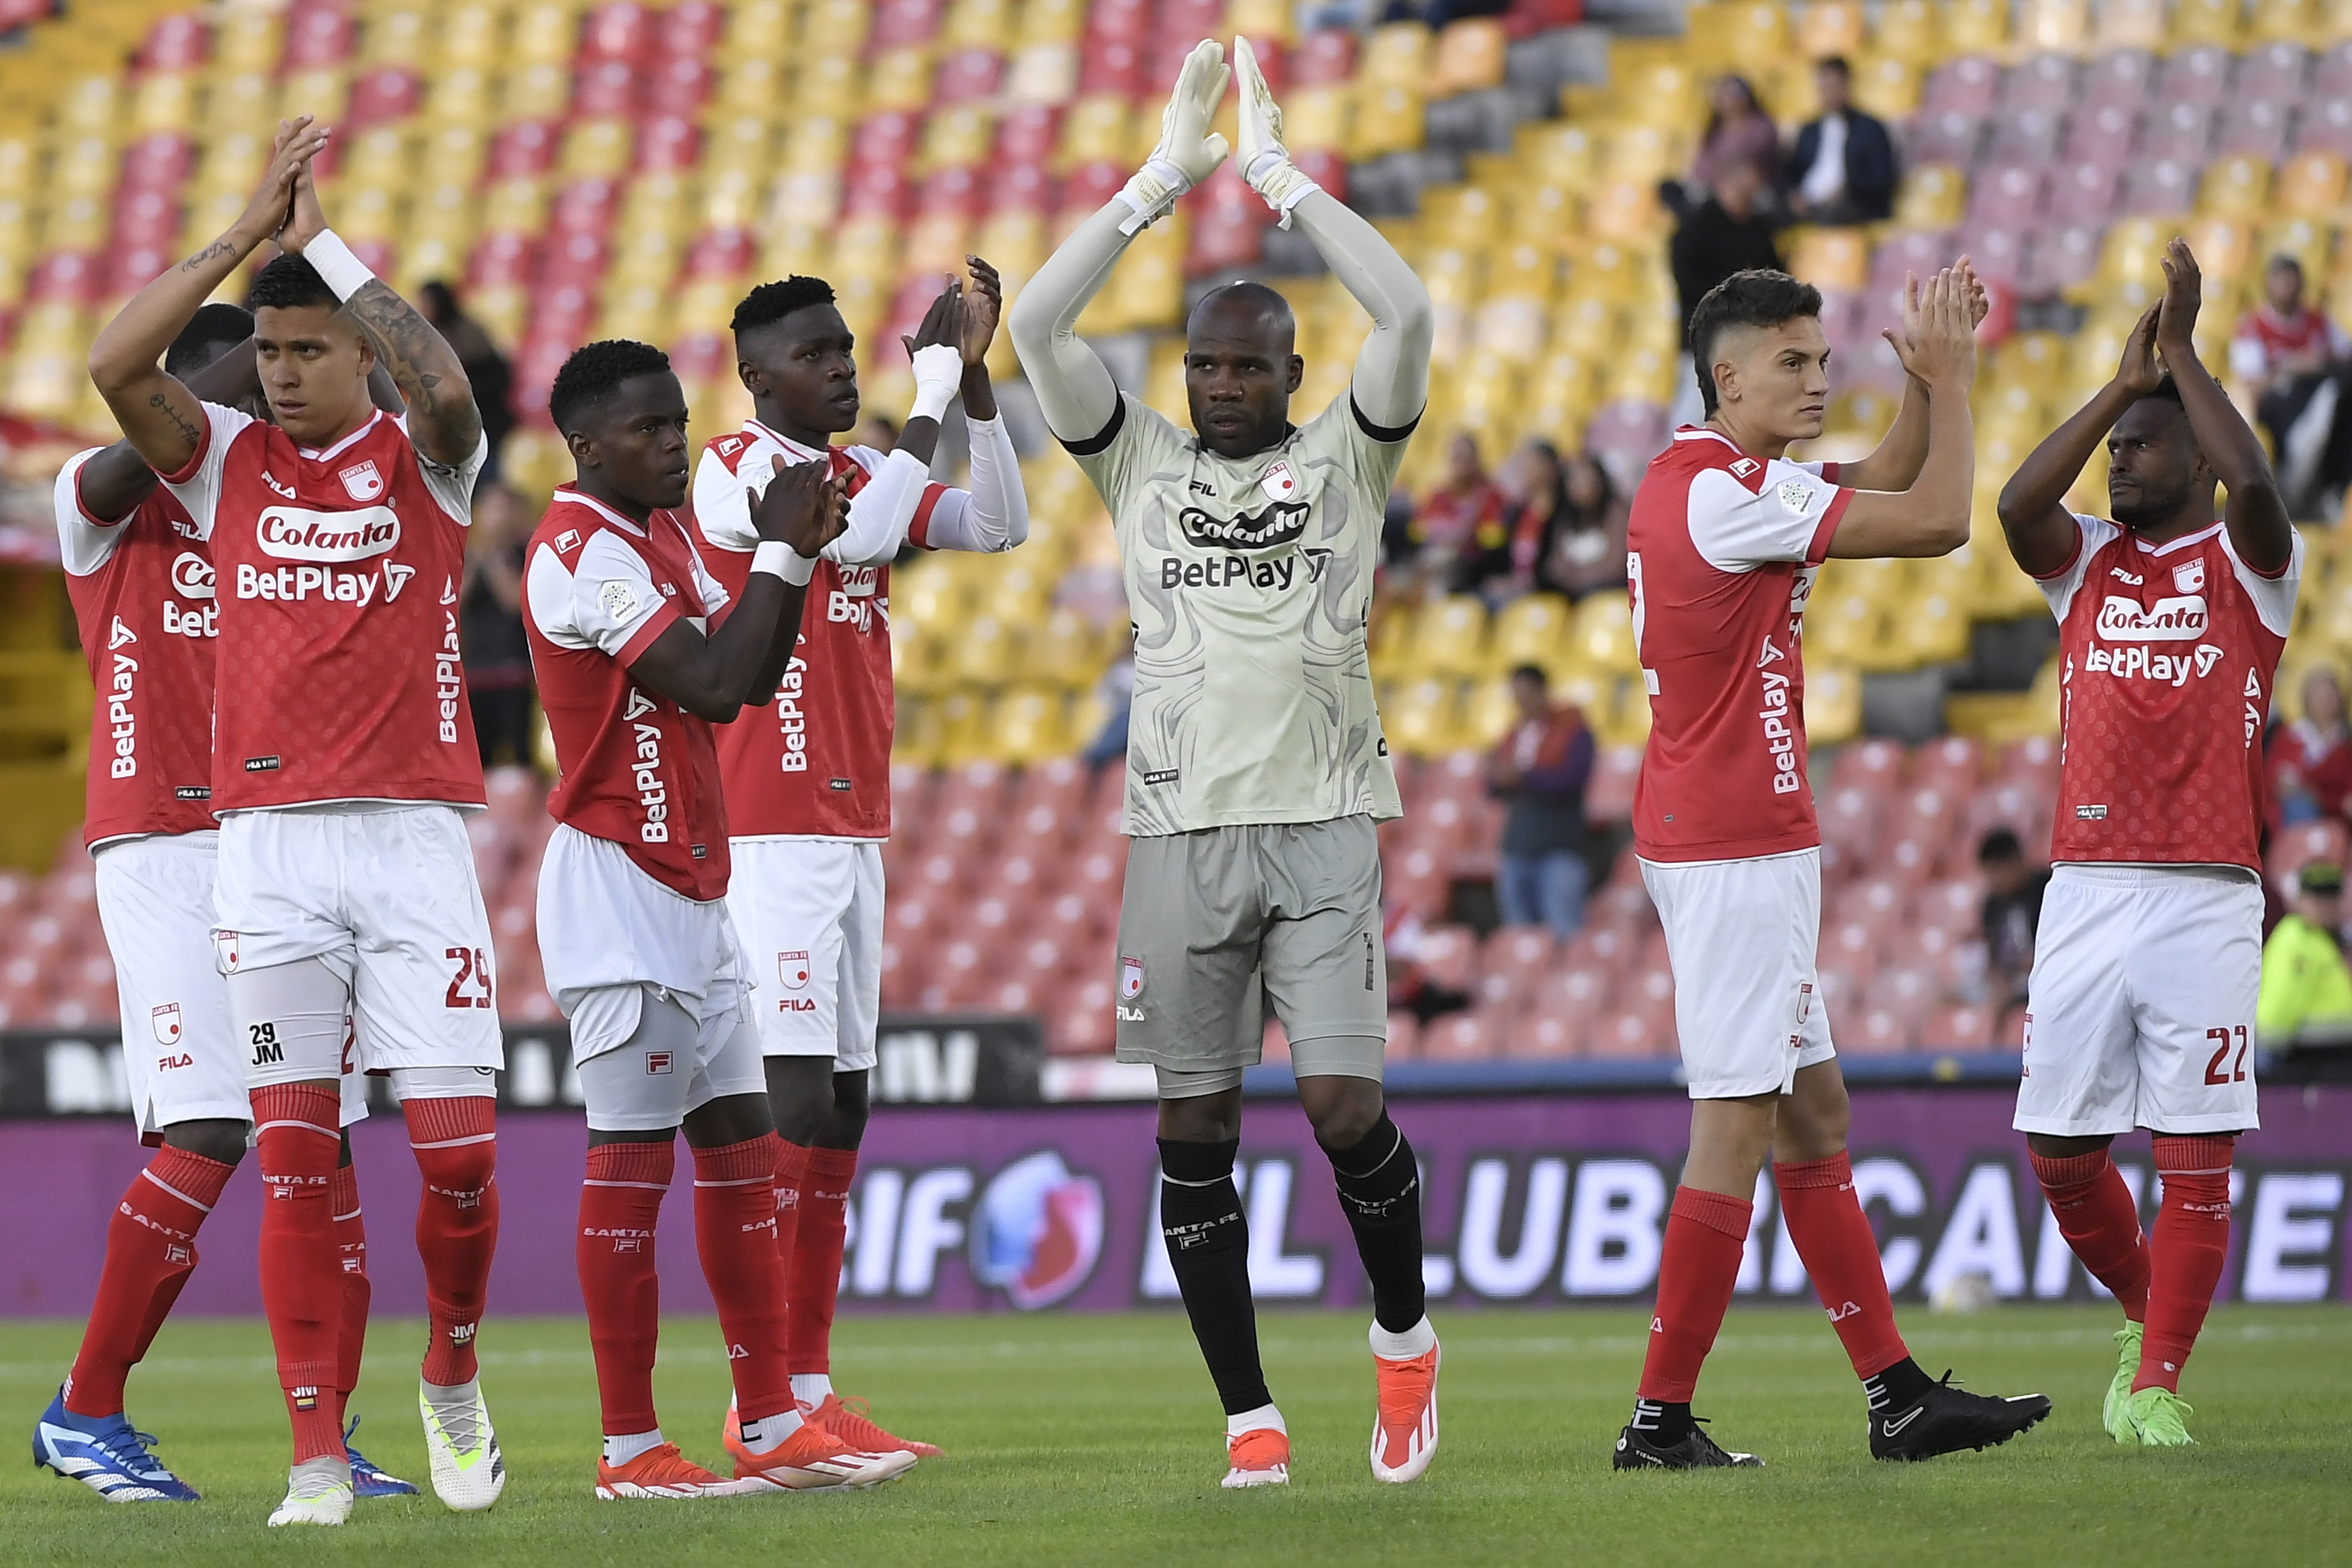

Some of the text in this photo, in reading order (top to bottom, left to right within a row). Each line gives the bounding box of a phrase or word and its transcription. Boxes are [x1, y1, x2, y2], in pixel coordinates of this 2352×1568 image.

[342, 462, 373, 479] SANTA FE
[261, 469, 297, 500] FILA
[1188, 480, 1217, 497] FIL
[261, 515, 395, 550] Colanta
[1181, 507, 1310, 543] Colanta
[1162, 555, 1295, 592] BetPlay
[2110, 566, 2144, 586] FILA
[237, 563, 380, 608] BetPlay
[108, 653, 139, 779] BetPlay
[775, 655, 808, 772] BetPlay
[1759, 669, 1800, 795] BetPlay
[631, 723, 669, 844] BetPlay
[1362, 932, 1374, 992] 1
[445, 947, 493, 1009] 29
[779, 998, 817, 1013] FILA
[1116, 1006, 1145, 1022] FILA
[249, 1022, 276, 1045] 29
[1789, 1034, 1803, 1048] FIL
[158, 1053, 194, 1072] FILA
[251, 1043, 284, 1065] JM
[2204, 1025, 2248, 1086] 22
[308, 1175, 327, 1185] FE
[2182, 1202, 2230, 1212] SANT
[119, 1201, 194, 1243] SANT
[583, 1227, 649, 1238] SANTA
[741, 1217, 776, 1233] SAN
[1164, 1211, 1240, 1237] ANTA FE
[1826, 1301, 1862, 1322] ILA
[449, 1322, 476, 1339] JM
[291, 1385, 318, 1398] JM
